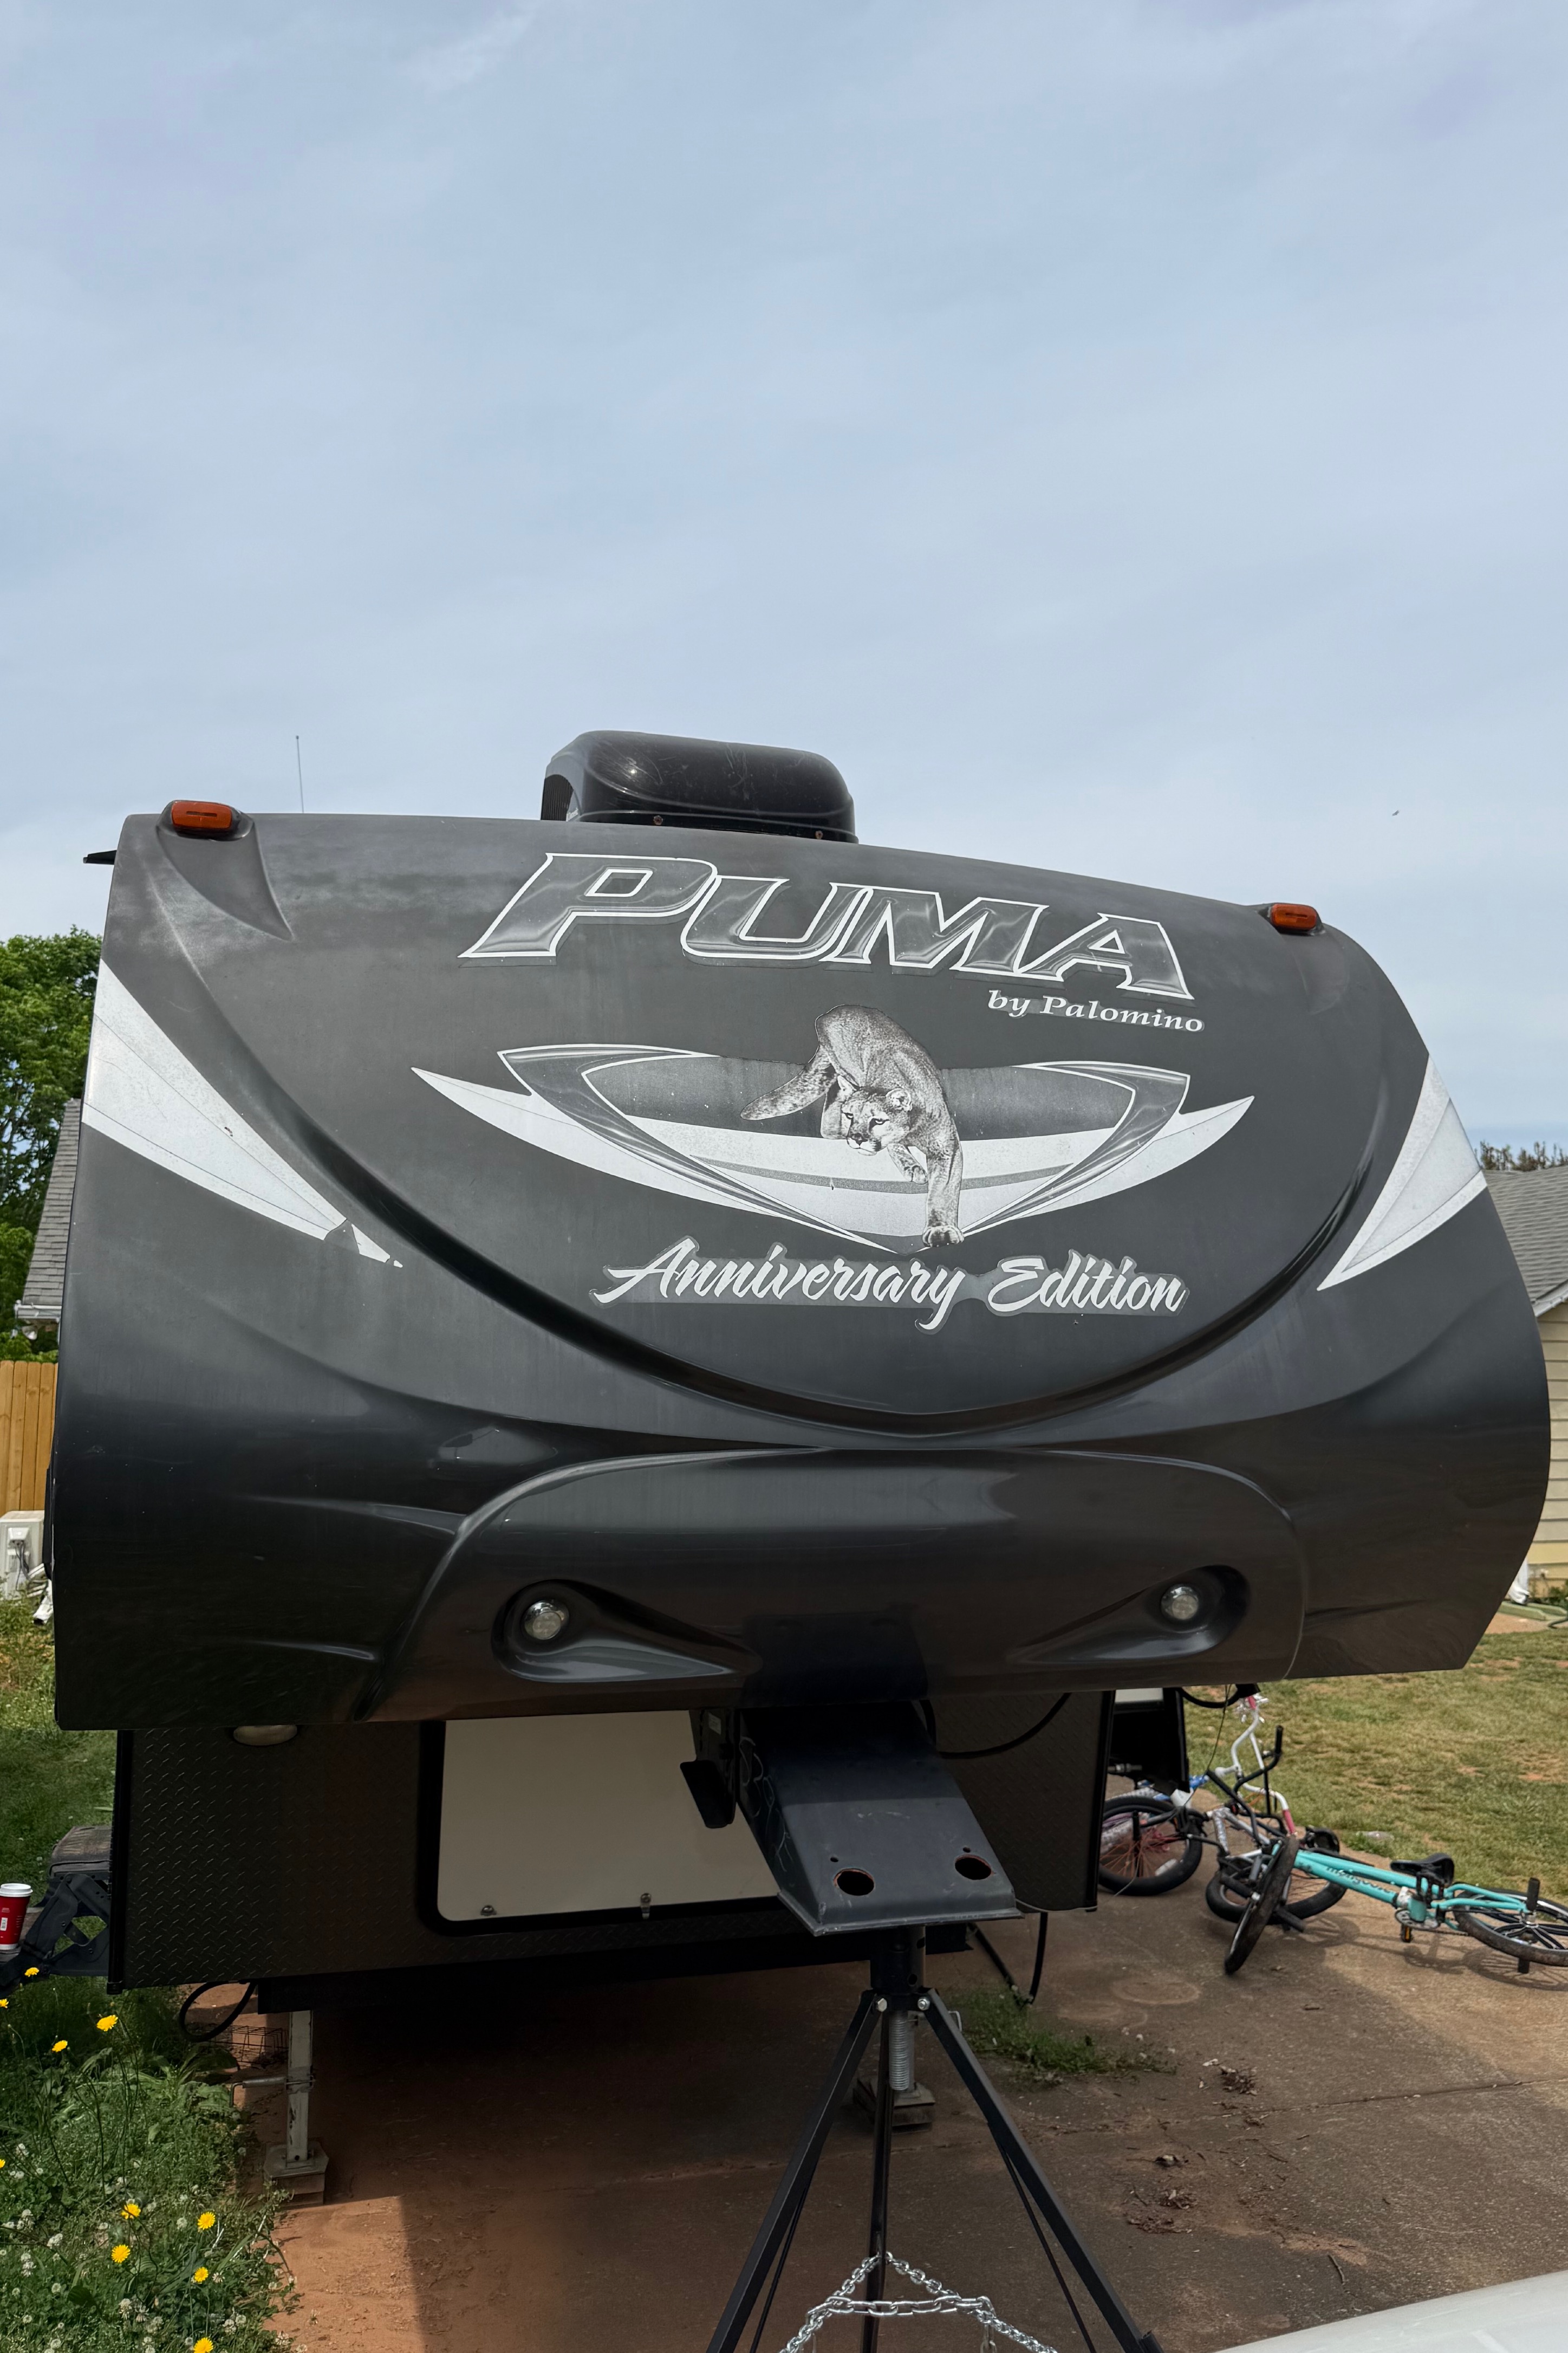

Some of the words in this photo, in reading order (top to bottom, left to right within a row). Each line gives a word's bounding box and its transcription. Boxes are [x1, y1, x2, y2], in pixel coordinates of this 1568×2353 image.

[458, 853, 1194, 1000] PUMA
[987, 990, 1030, 1017] by
[1040, 995, 1202, 1032] Palomino
[594, 1238, 966, 1330] Anniversary
[988, 1252, 1186, 1312] Edition
